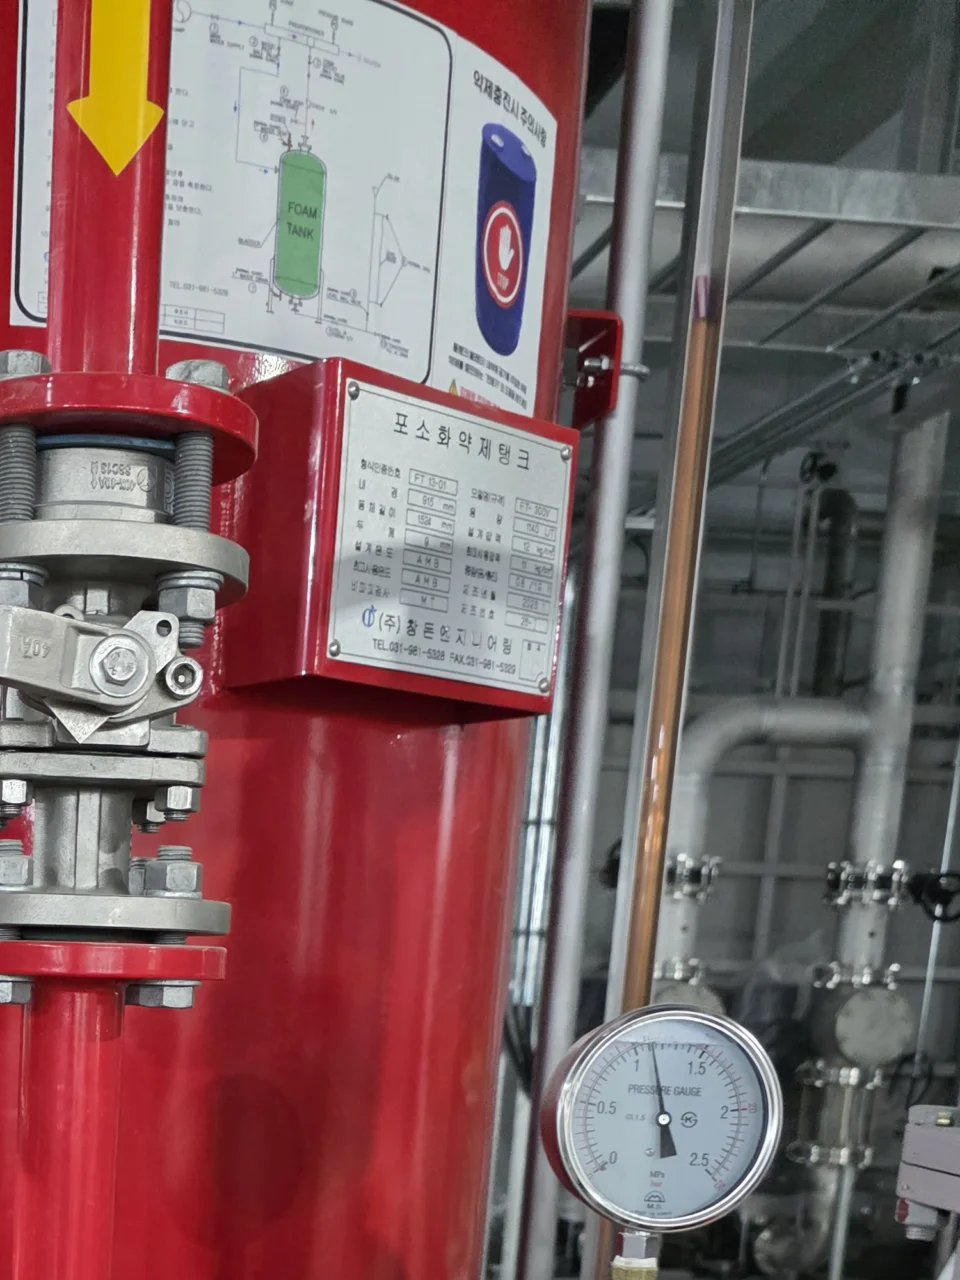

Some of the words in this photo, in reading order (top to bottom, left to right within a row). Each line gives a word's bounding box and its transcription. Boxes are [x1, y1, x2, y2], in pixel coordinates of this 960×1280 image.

[287, 202, 318, 220] FOAM
[286, 222, 314, 241] TANK
[393, 412, 530, 471] 포소화약제탱크
[414, 473, 425, 484] FT
[372, 638, 446, 662] TEL.031-981-5328
[634, 1061, 640, 1072] 1
[688, 1062, 706, 1076] 1.5
[673, 1086, 702, 1096] GAUGE
[596, 1101, 616, 1115] 0.5
[720, 1105, 728, 1120] 2
[609, 1150, 618, 1164] 0
[690, 1152, 710, 1167] 2.5
